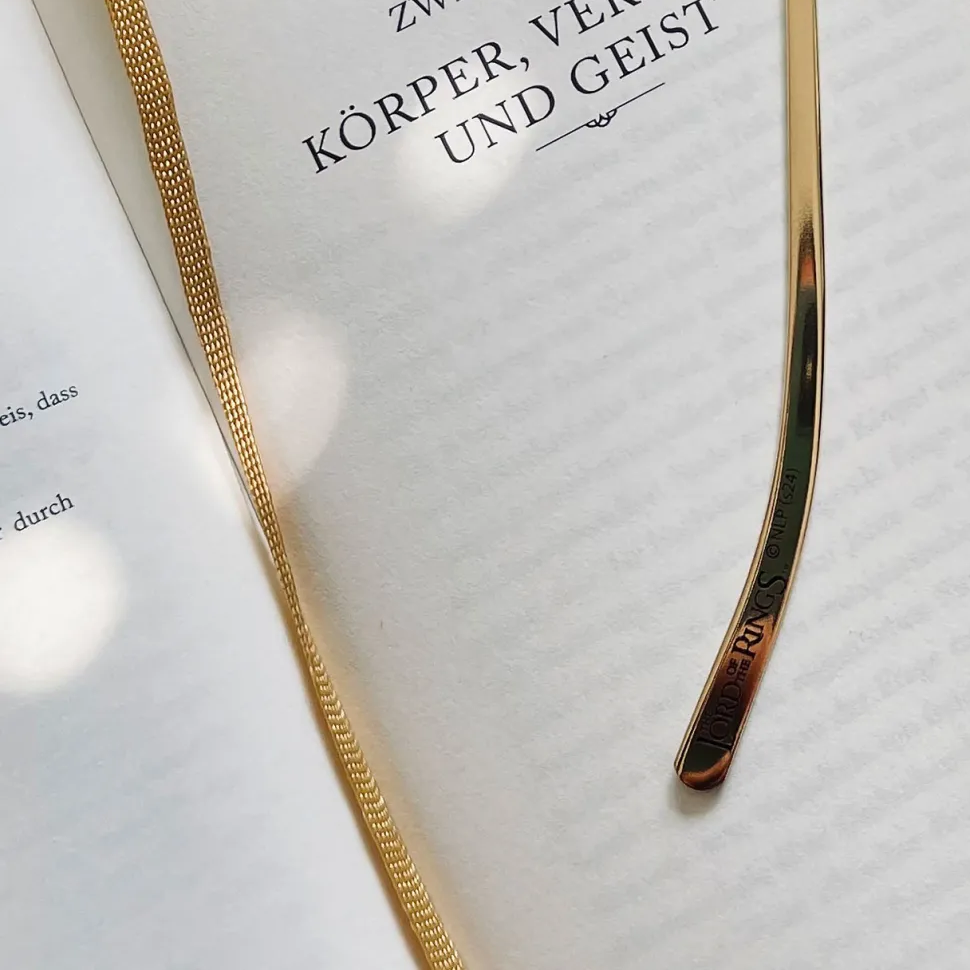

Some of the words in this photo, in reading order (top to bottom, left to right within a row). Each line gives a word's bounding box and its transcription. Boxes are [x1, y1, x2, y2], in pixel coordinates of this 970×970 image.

[301, 40, 531, 175] KÖRPER,
[434, 84, 556, 164] UND
[37, 385, 79, 411] dass
[13, 493, 75, 532] durch
[771, 509, 788, 540] NLP
[731, 571, 787, 660] RINGS
[726, 658, 738, 675] OF
[738, 658, 751, 681] THE
[697, 681, 743, 750] LORD
